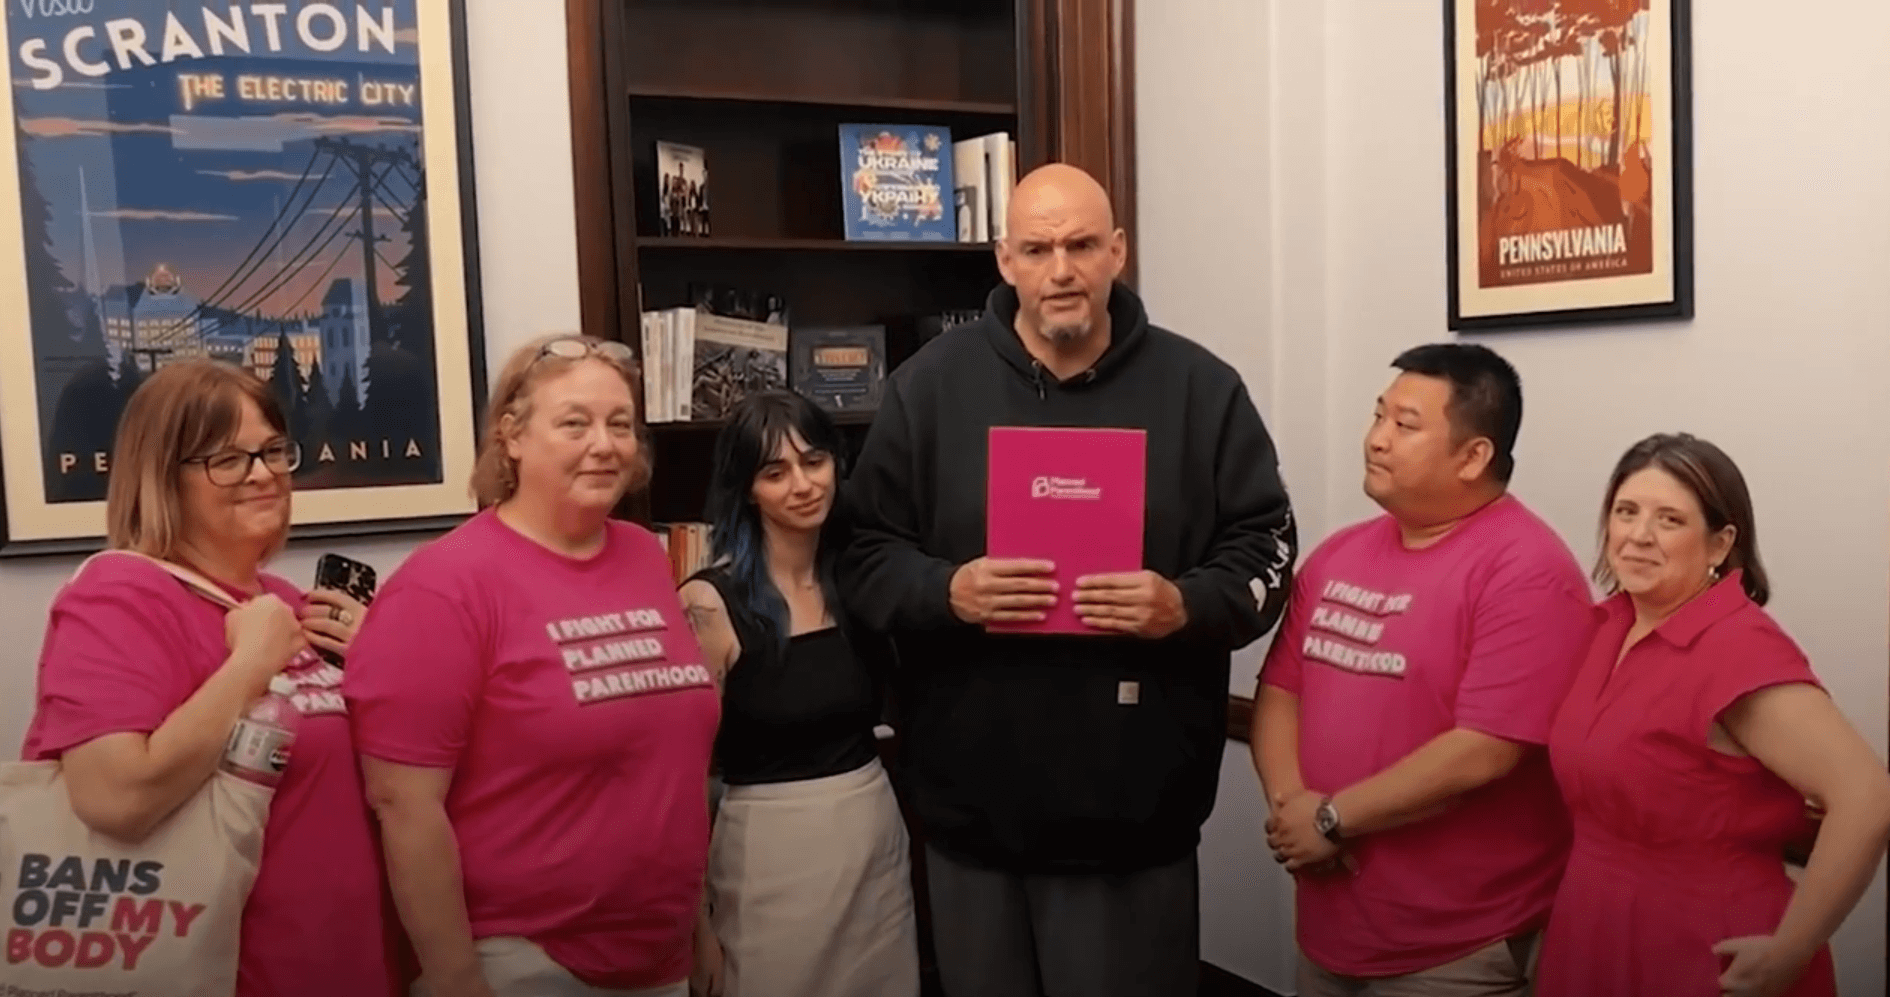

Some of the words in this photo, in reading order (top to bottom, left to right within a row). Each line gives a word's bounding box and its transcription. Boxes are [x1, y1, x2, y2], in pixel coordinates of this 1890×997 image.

[19, 3, 396, 90] SCRANTON
[178, 74, 225, 110] THE
[237, 74, 348, 104] ELECTRIC
[360, 80, 415, 106] CITY
[858, 155, 940, 171] UKRAINE
[1499, 222, 1628, 266] PENNSYLVANIA
[1500, 267, 1532, 279] UNITED
[1535, 263, 1567, 276] STATES
[1570, 261, 1582, 272] OF
[1585, 257, 1628, 271] AMERICA
[1050, 477, 1086, 487] Planned
[1323, 580, 1334, 597] I
[1330, 581, 1385, 612] FIGHT
[545, 622, 562, 641] I
[559, 612, 627, 639] FIGHT
[624, 607, 668, 627] FOR
[561, 637, 664, 671] PLANNED
[572, 664, 711, 701] PARENTHOOD
[18, 853, 165, 896] BANS
[13, 889, 111, 928] OFF
[109, 895, 207, 938] MY
[6, 928, 156, 971] BODY
